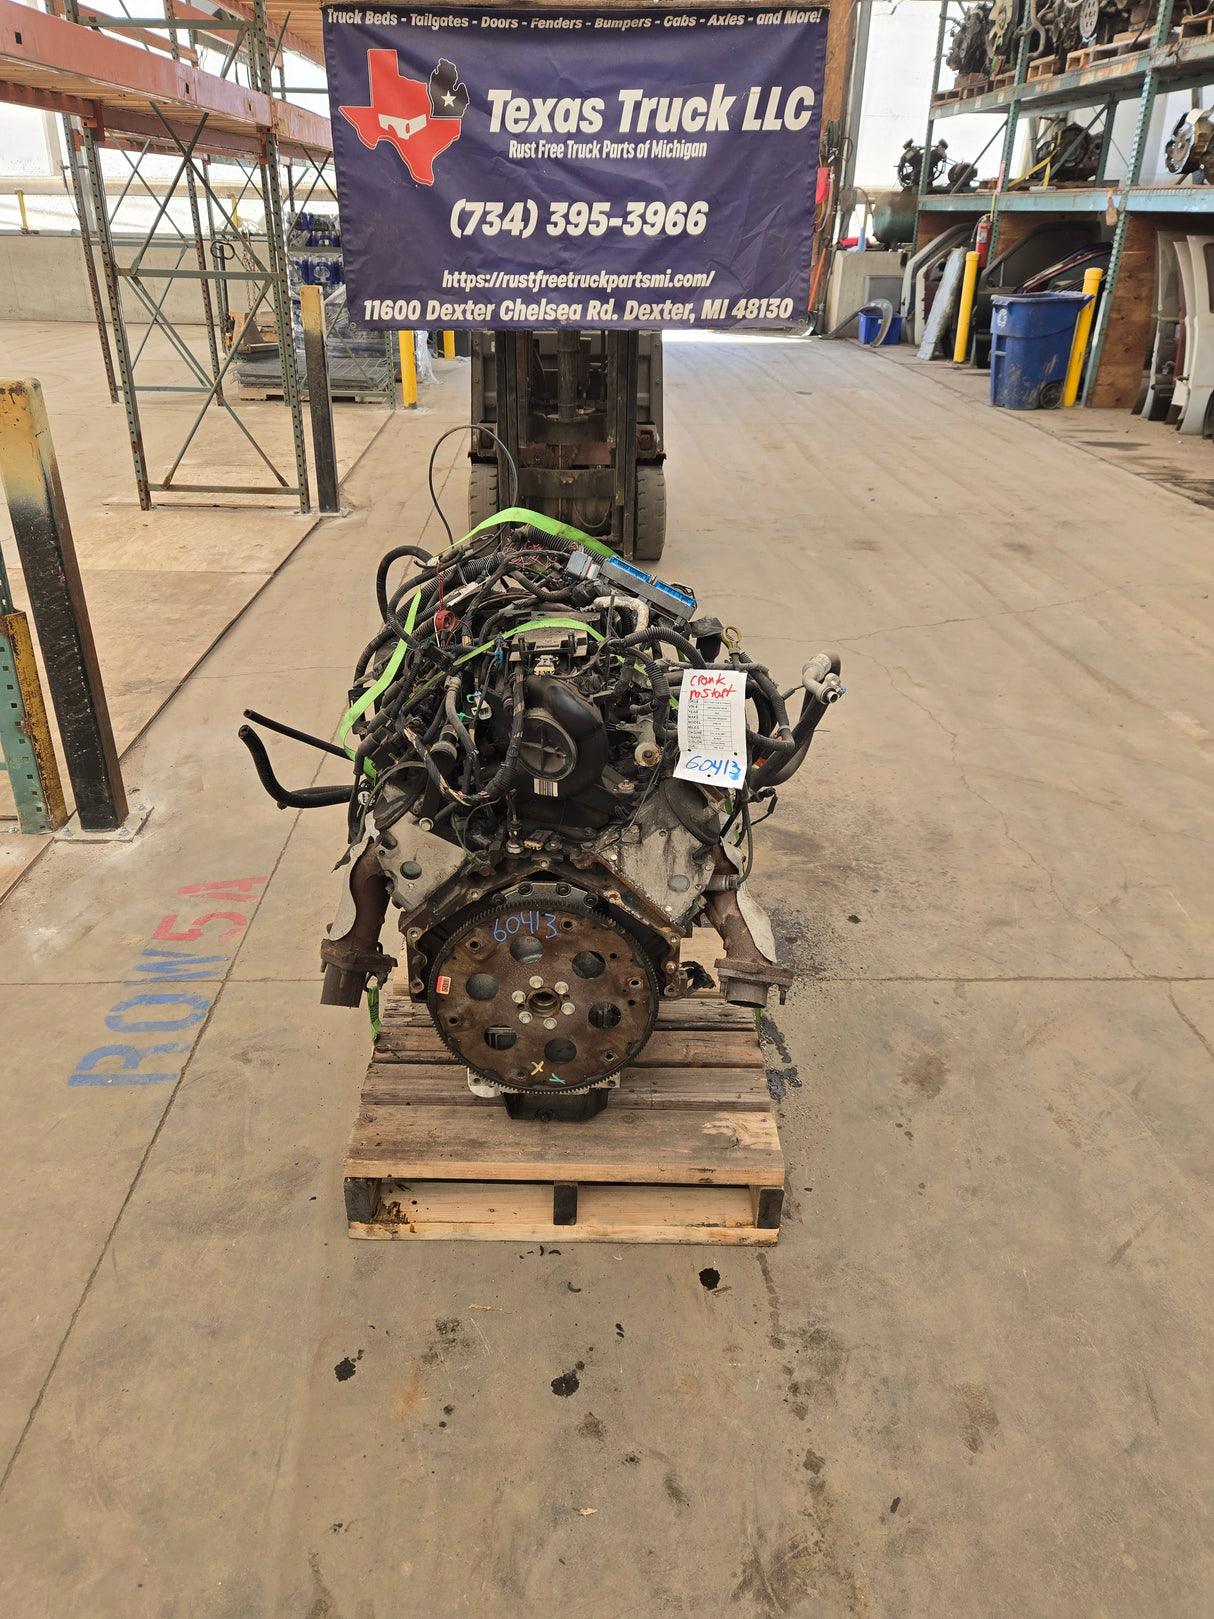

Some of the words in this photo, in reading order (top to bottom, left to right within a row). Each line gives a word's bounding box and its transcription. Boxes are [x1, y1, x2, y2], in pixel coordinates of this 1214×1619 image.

[328, 9, 362, 24] Truck
[365, 11, 398, 25] Beds
[410, 13, 469, 30] Tailgates
[481, 16, 518, 28] Doors
[530, 17, 582, 29] Fenders
[594, 18, 652, 31] Bumpers
[664, 14, 697, 27] Cabs
[708, 13, 745, 26] Axles
[757, 11, 781, 24] and
[784, 9, 822, 24] More!
[488, 89, 605, 133] Texas
[619, 84, 737, 133] Truck
[742, 85, 815, 131] LLC
[509, 140, 536, 159] Rust
[538, 140, 564, 159] Free
[567, 140, 601, 159] Truck
[602, 140, 635, 159] Parts
[636, 140, 651, 158] of
[651, 140, 707, 160] Michigan
[450, 198, 538, 238] (734)
[546, 201, 709, 237] 395-3966
[442, 268, 716, 293] https://rustfreetruckpartsmi.com/
[363, 300, 421, 320] 11600
[426, 300, 496, 321] Dexter
[500, 298, 581, 321] Chelsea
[587, 298, 618, 321] Rd.
[624, 300, 696, 323] Dexter,
[701, 299, 729, 320] MI
[732, 298, 793, 319] 48130
[686, 756, 741, 776] 60413
[493, 911, 557, 942] 60413
[67, 949, 230, 1086] ROW
